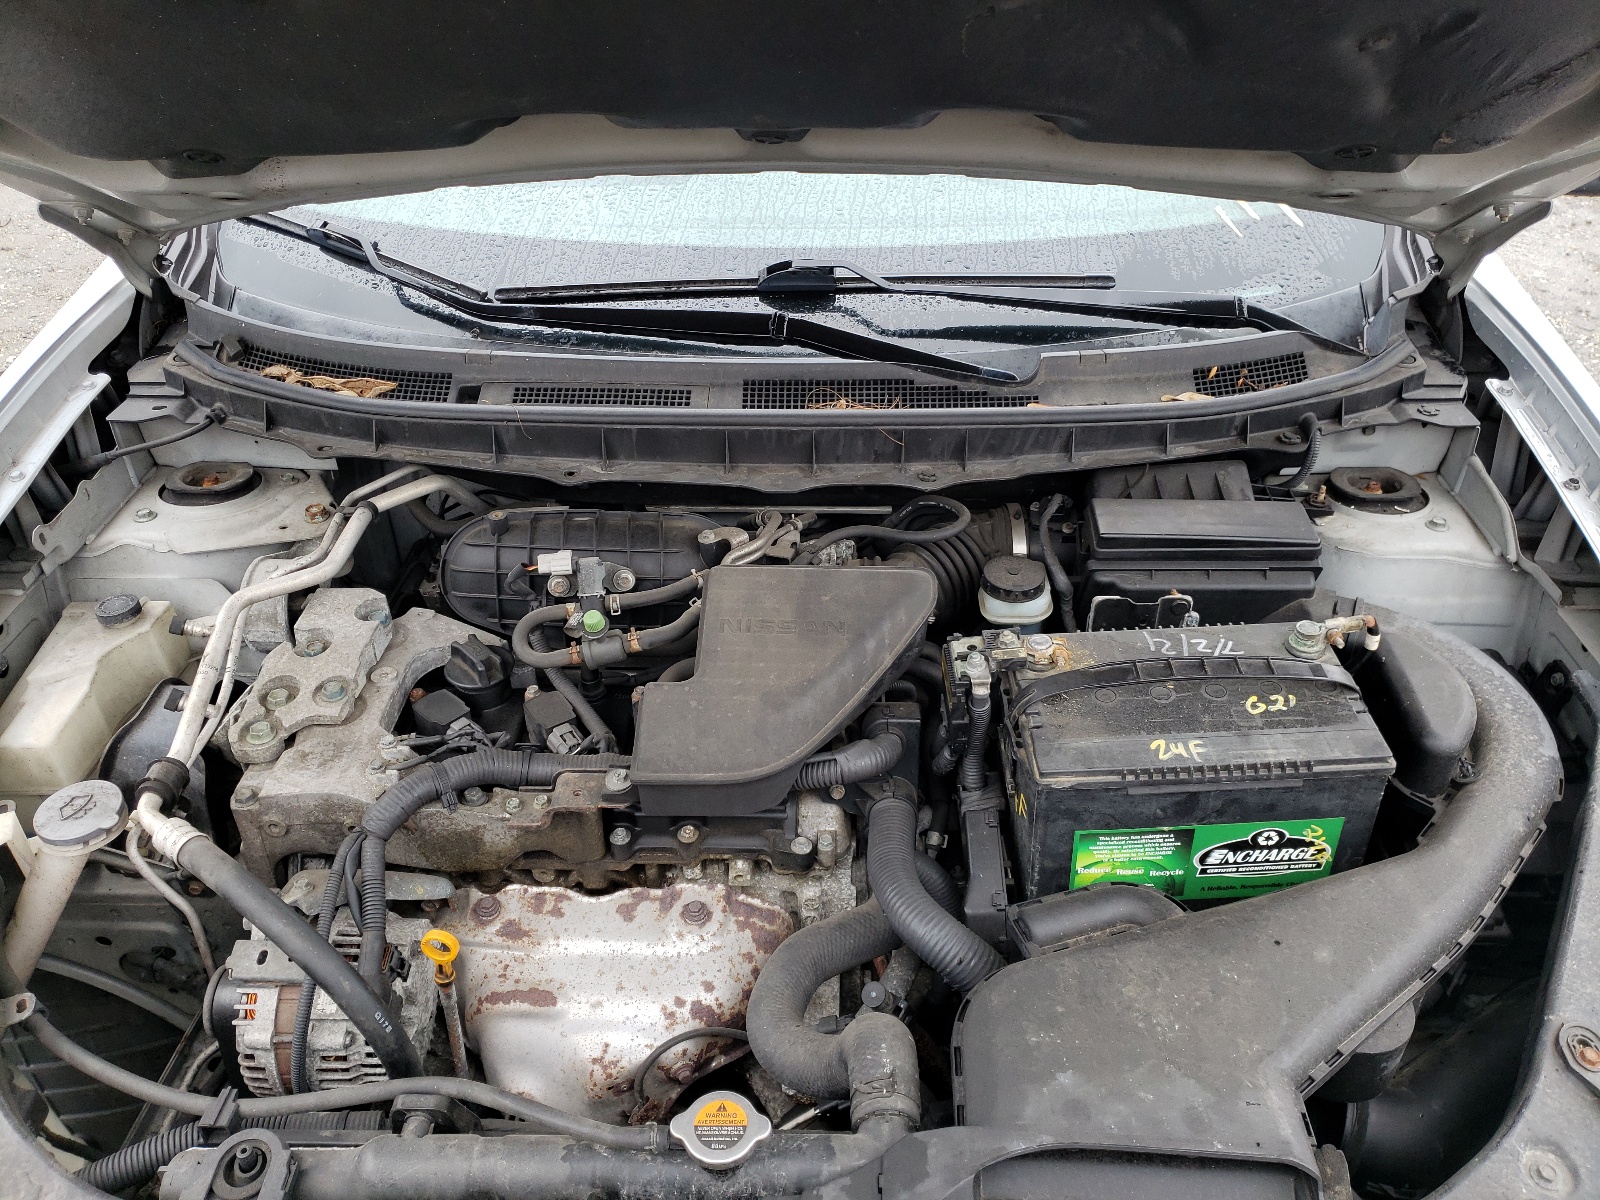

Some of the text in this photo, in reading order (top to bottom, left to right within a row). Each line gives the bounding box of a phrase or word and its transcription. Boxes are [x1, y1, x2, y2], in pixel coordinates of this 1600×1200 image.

[719, 618, 849, 636] NISSAN
[1203, 847, 1318, 864] ENCHARGE
[1150, 868, 1184, 877] Recycle
